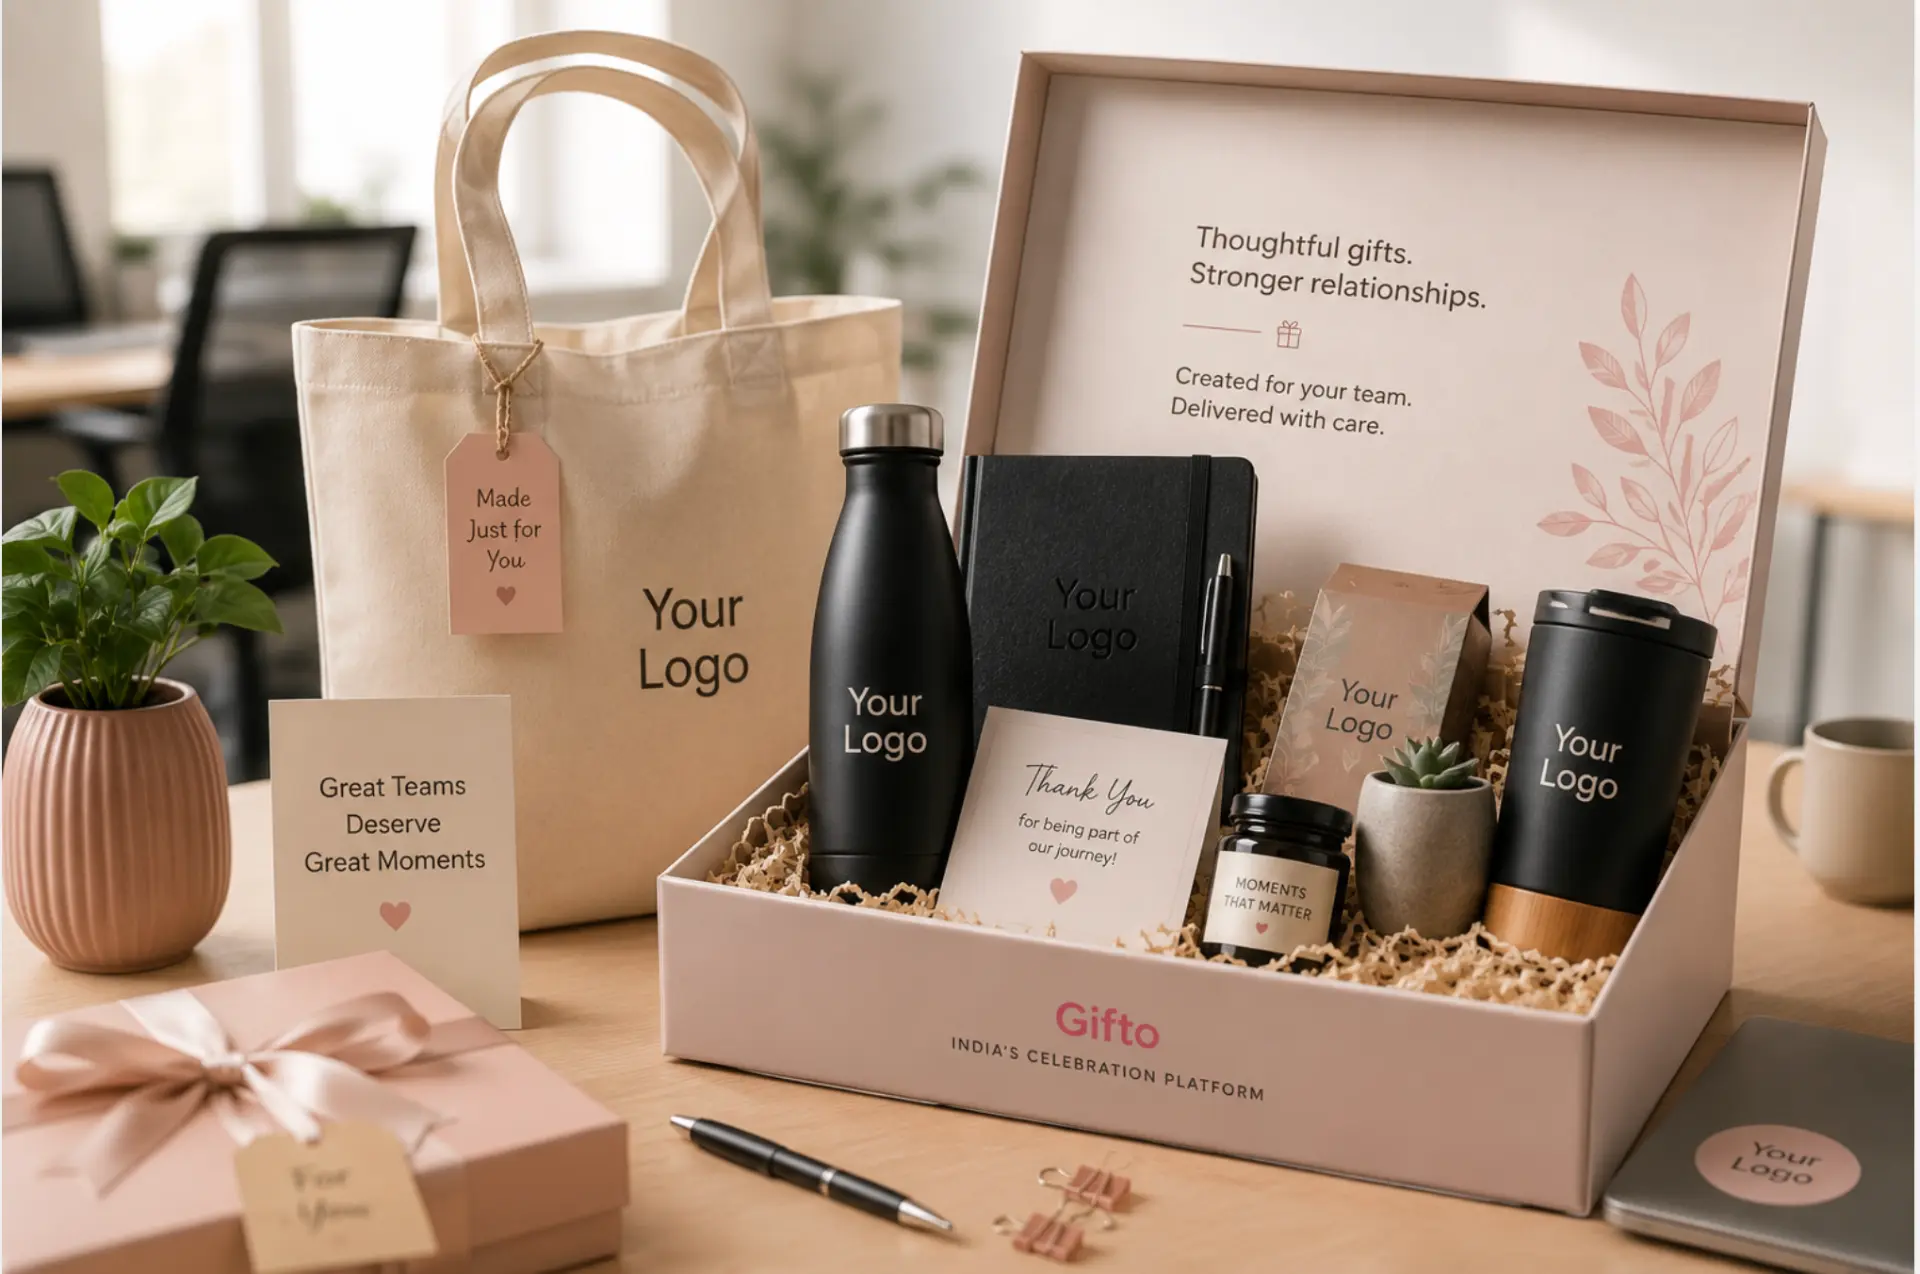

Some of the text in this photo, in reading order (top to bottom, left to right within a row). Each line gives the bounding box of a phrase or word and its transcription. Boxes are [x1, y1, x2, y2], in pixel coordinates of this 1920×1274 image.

[1197, 226, 1413, 266] Thoughtful gifts.
[1190, 262, 1487, 311] Stronger relationships.
[1175, 366, 1412, 407] Created for your team.
[1171, 397, 1385, 435] Delivered with care.
[476, 487, 531, 508] Made
[467, 519, 542, 543] Just for
[487, 549, 526, 573] You
[643, 587, 744, 630] Your
[1055, 577, 1137, 612] Your
[1047, 619, 1139, 660] Logo
[639, 648, 749, 697] Logo
[848, 687, 922, 716] Your
[1341, 678, 1399, 710] Your
[1325, 707, 1393, 743] Logo
[844, 725, 927, 761] Logo
[1554, 723, 1623, 763] Your
[319, 775, 466, 798] Great Teams
[1025, 763, 1155, 815] Thank You
[1539, 757, 1618, 803] Logo
[346, 813, 441, 835] Deserve
[1018, 813, 1140, 846] for being part of
[304, 849, 486, 873] Great Moments
[1028, 841, 1117, 867] our journey!
[1235, 876, 1307, 899] MOMENTS
[1224, 894, 1313, 921] THAT MATTER
[1055, 1001, 1160, 1049] Gifto
[951, 1036, 1265, 1101] INDIA'S CELEBRATION PLATFORM
[1731, 1156, 1814, 1185] Logo
[1753, 1141, 1822, 1167] Your
